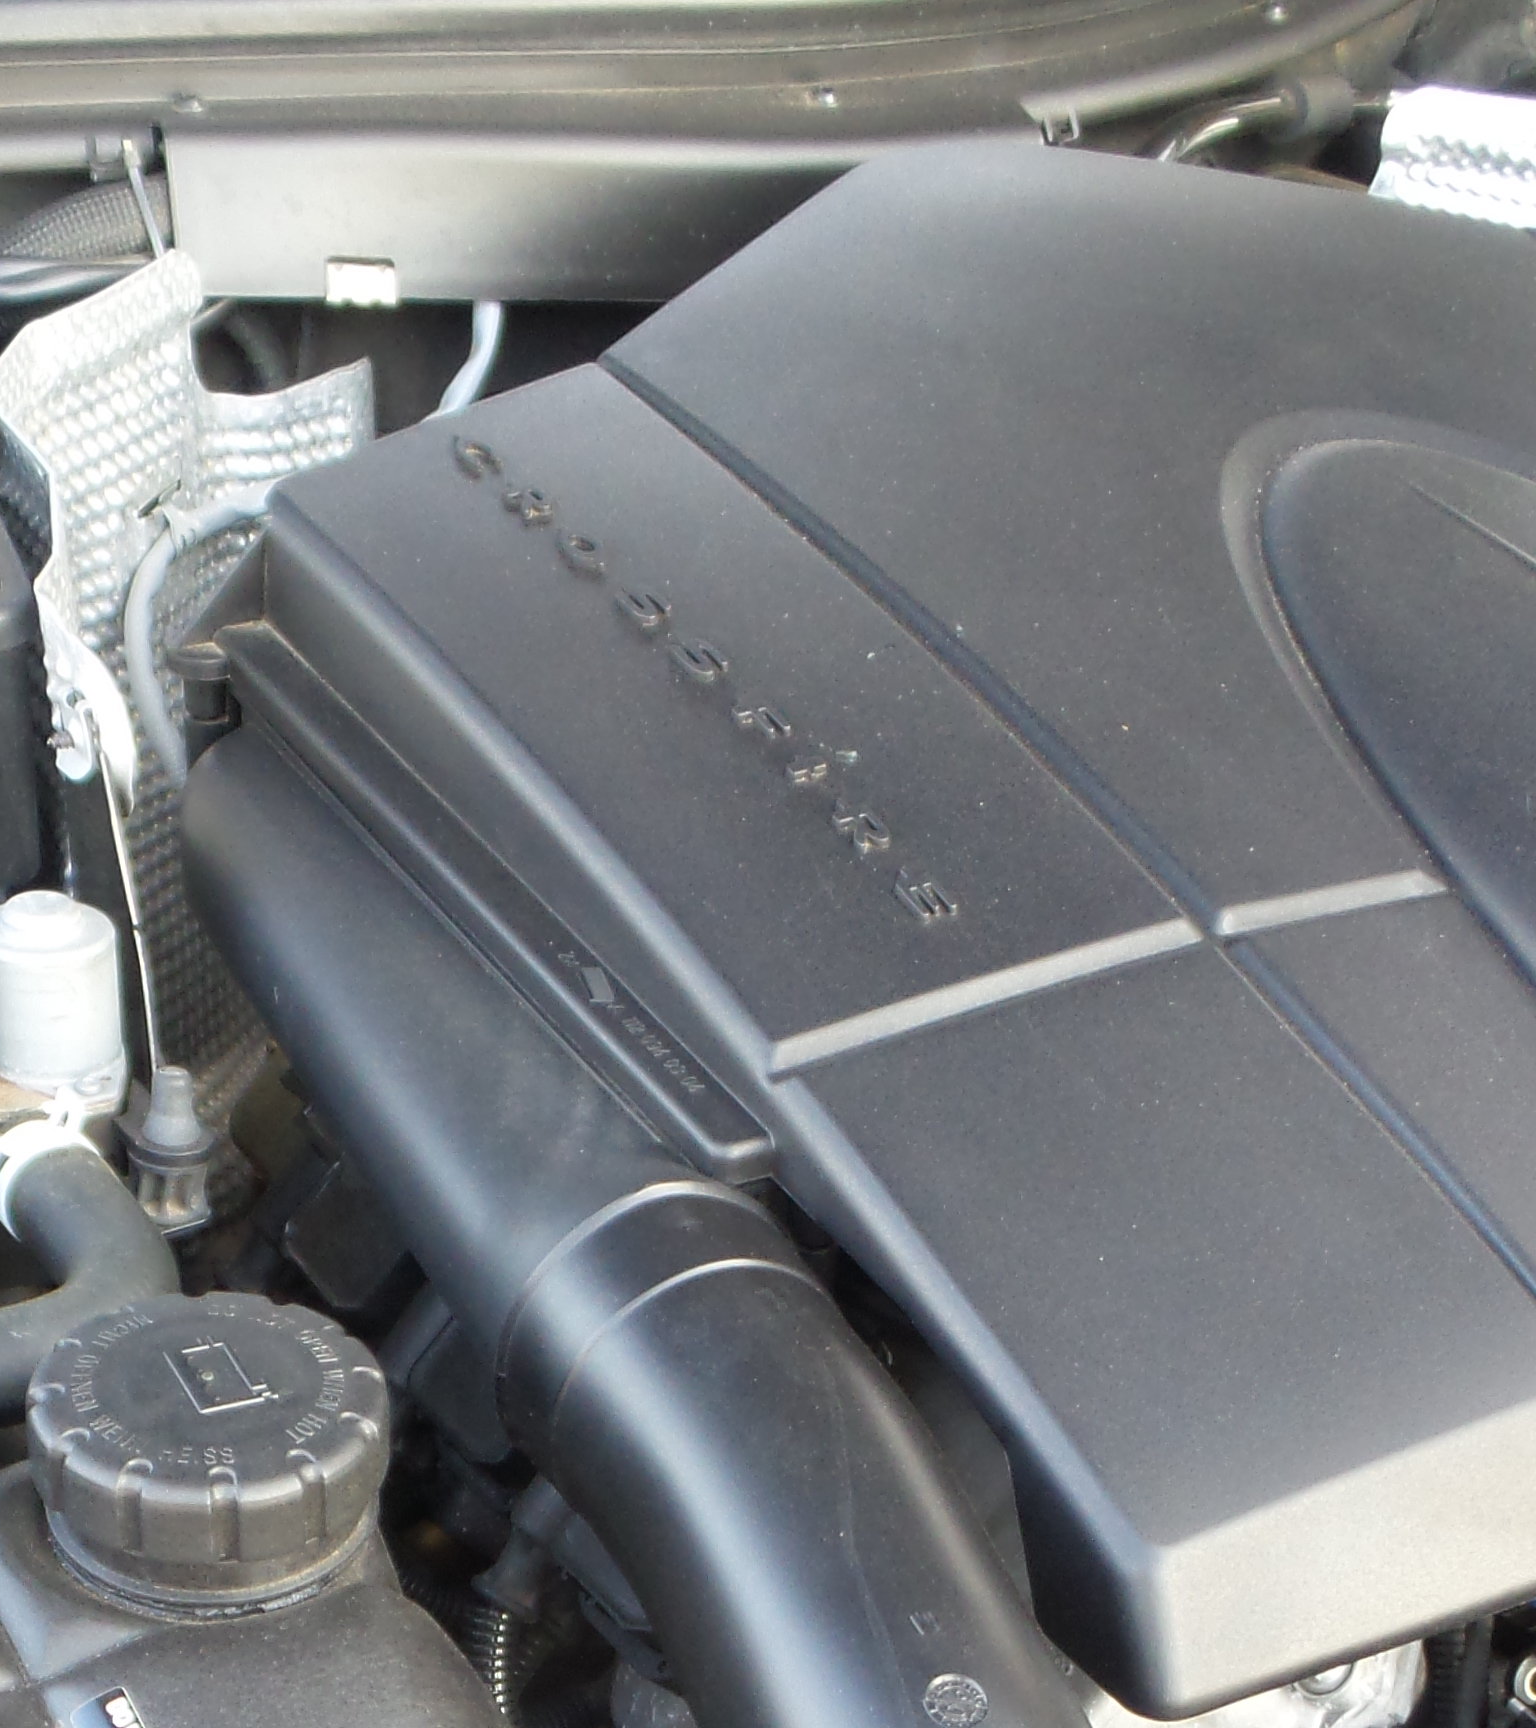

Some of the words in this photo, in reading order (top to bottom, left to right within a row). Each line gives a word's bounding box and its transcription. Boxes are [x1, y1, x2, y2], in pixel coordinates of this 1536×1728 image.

[454, 435, 958, 923] CROSSFIRE
[285, 1412, 327, 1445] HOT
[105, 1697, 135, 1728] DO
